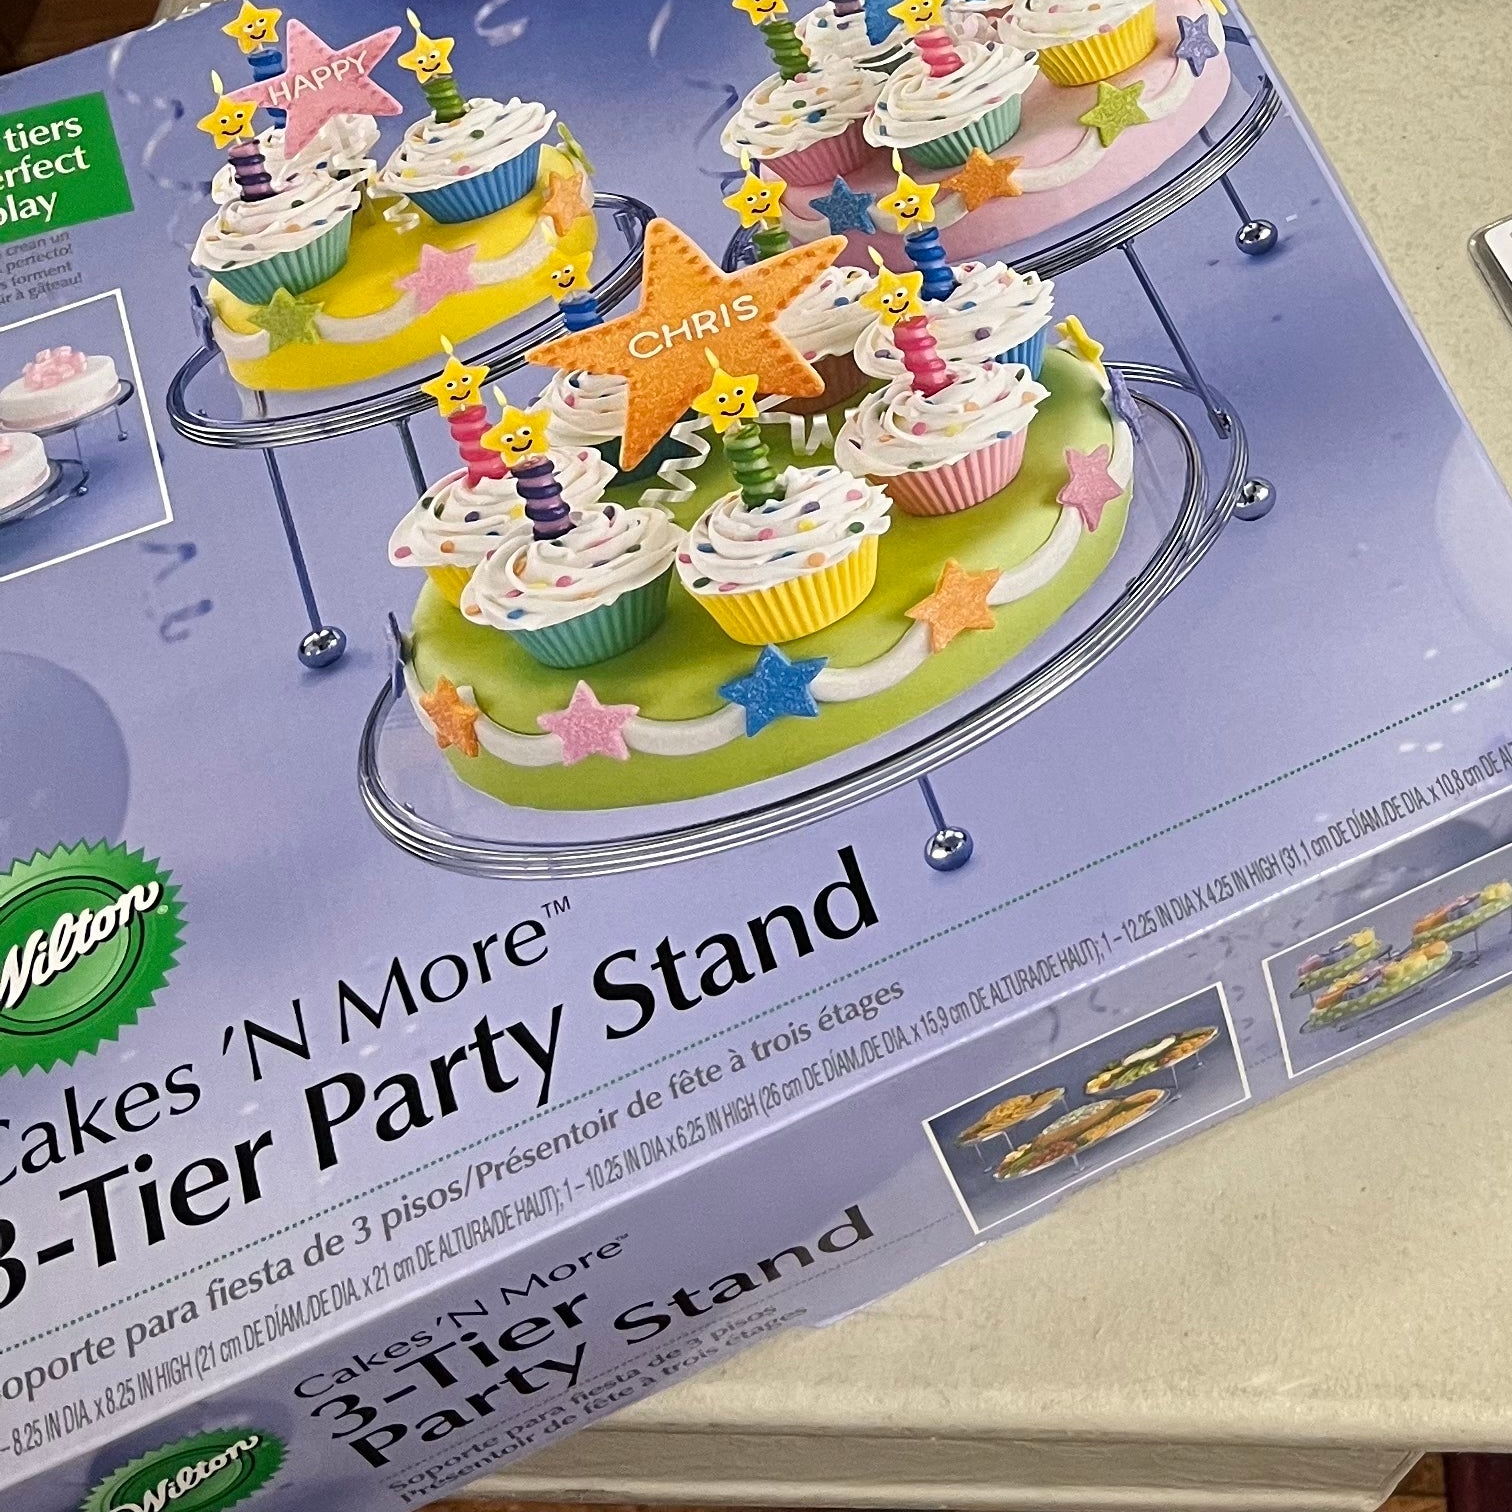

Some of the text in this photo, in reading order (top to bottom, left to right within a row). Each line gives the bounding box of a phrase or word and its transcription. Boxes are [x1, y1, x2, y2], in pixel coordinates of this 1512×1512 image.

[269, 51, 367, 106] HAPPY
[8, 116, 83, 154] tiers
[628, 295, 759, 359] CHRIS
[305, 1004, 564, 1171] Party
[593, 845, 879, 1040] Stand
[0, 1337, 115, 1402] oporte
[126, 1300, 198, 1357] para
[206, 1257, 294, 1311] fiesta
[304, 1233, 345, 1266] de
[352, 1216, 371, 1245] 3
[627, 1090, 663, 1119] de
[668, 1064, 722, 1099] fête
[730, 1049, 746, 1072] à
[752, 1022, 811, 1062] trois
[818, 981, 905, 1031] étages
[11, 1420, 42, 1456] 8.25
[44, 1410, 62, 1443] IN
[105, 1378, 134, 1414] 8.25
[137, 1368, 154, 1401] IN
[155, 1351, 193, 1388] HIGH
[195, 1341, 217, 1382] (21
[220, 1336, 242, 1363] cm
[243, 1319, 265, 1353] DE
[372, 1263, 389, 1291] 21
[393, 1256, 416, 1283] cm
[415, 1239, 437, 1271] DE
[293, 1330, 434, 1400] Cakes
[310, 1291, 589, 1440] 3-Tier
[349, 1204, 875, 1469] Party Stand
[505, 1406, 565, 1439] para
[569, 1369, 643, 1405] fiesta
[648, 1349, 682, 1368] de
[711, 1304, 777, 1338] pisos
[543, 1412, 577, 1434] de
[662, 1346, 719, 1376] trois
[109, 1435, 258, 1512] Wilton
